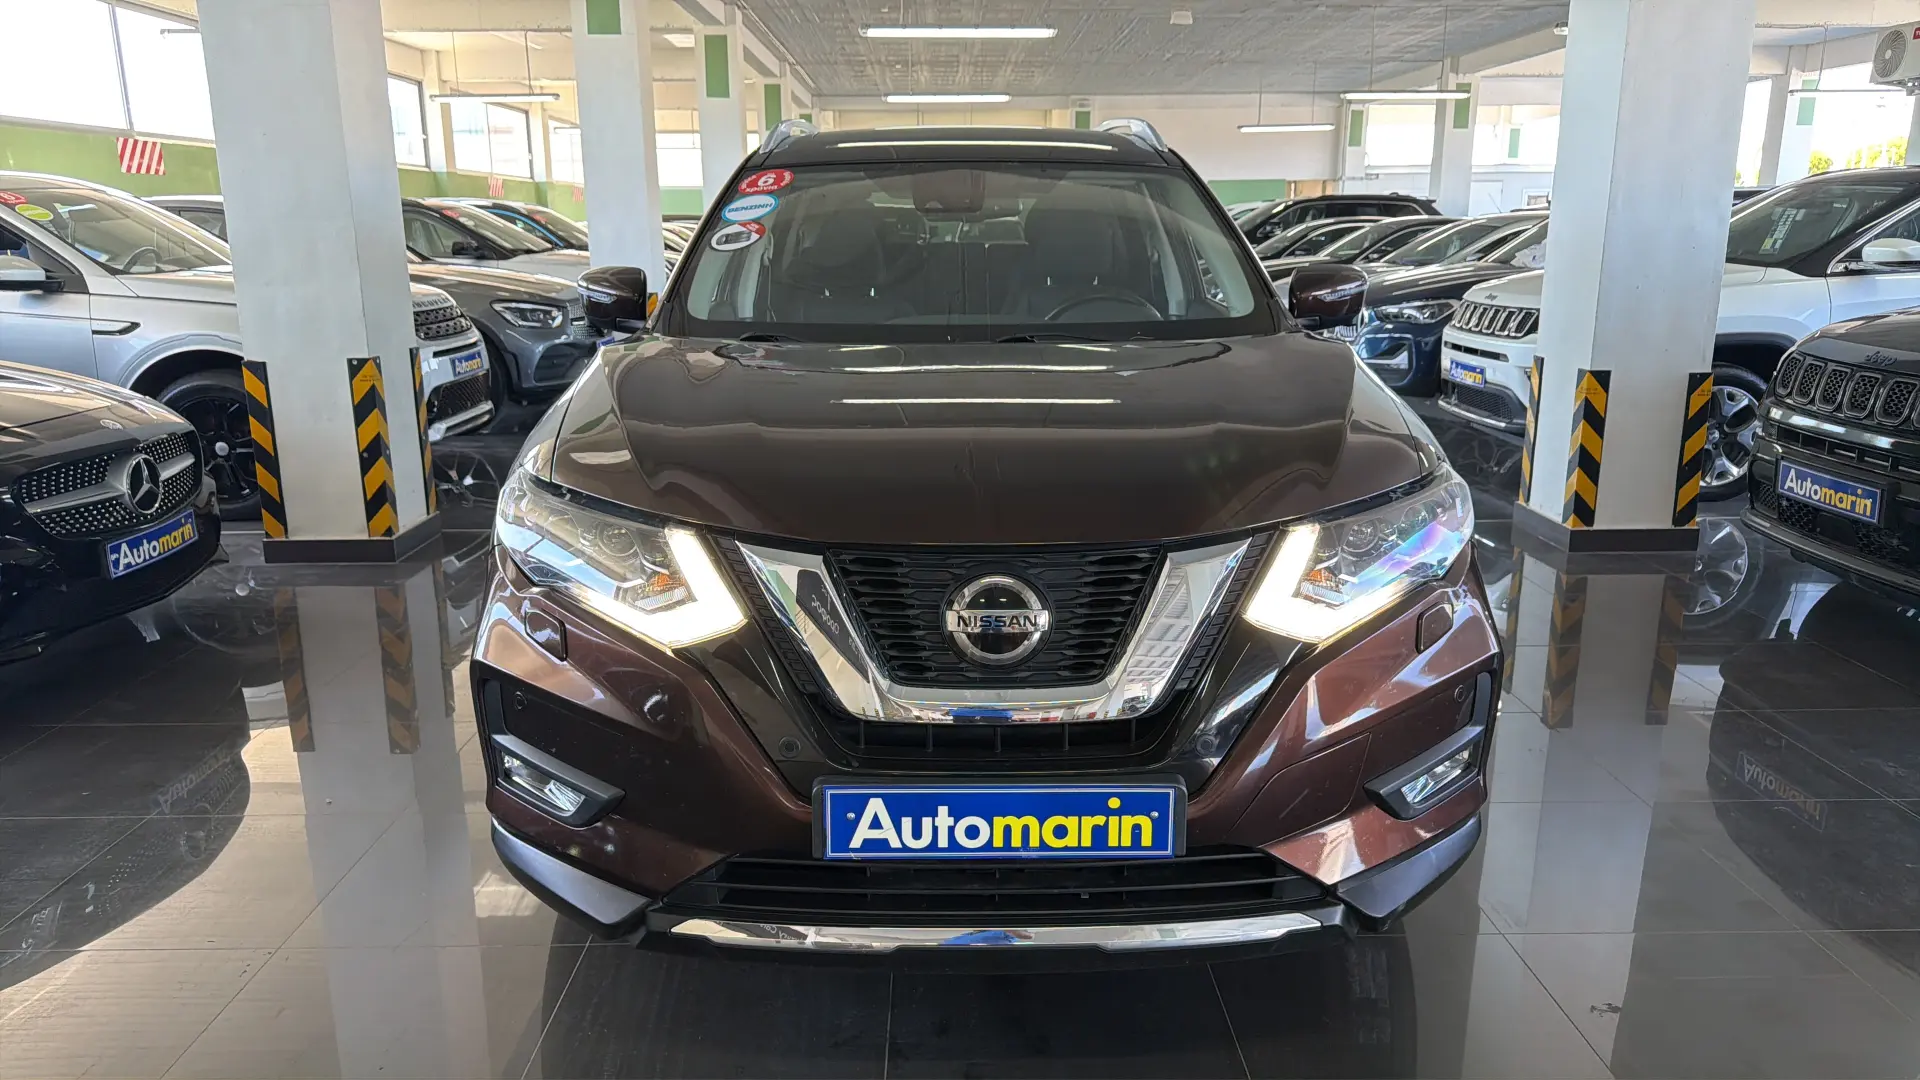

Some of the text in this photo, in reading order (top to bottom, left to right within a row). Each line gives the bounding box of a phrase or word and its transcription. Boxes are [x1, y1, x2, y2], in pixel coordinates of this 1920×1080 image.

[758, 173, 776, 187] 6
[1784, 468, 1872, 516] Automarin
[119, 518, 193, 570] Automarin
[957, 614, 1038, 628] NISSAN
[849, 797, 1153, 850] Automarin
